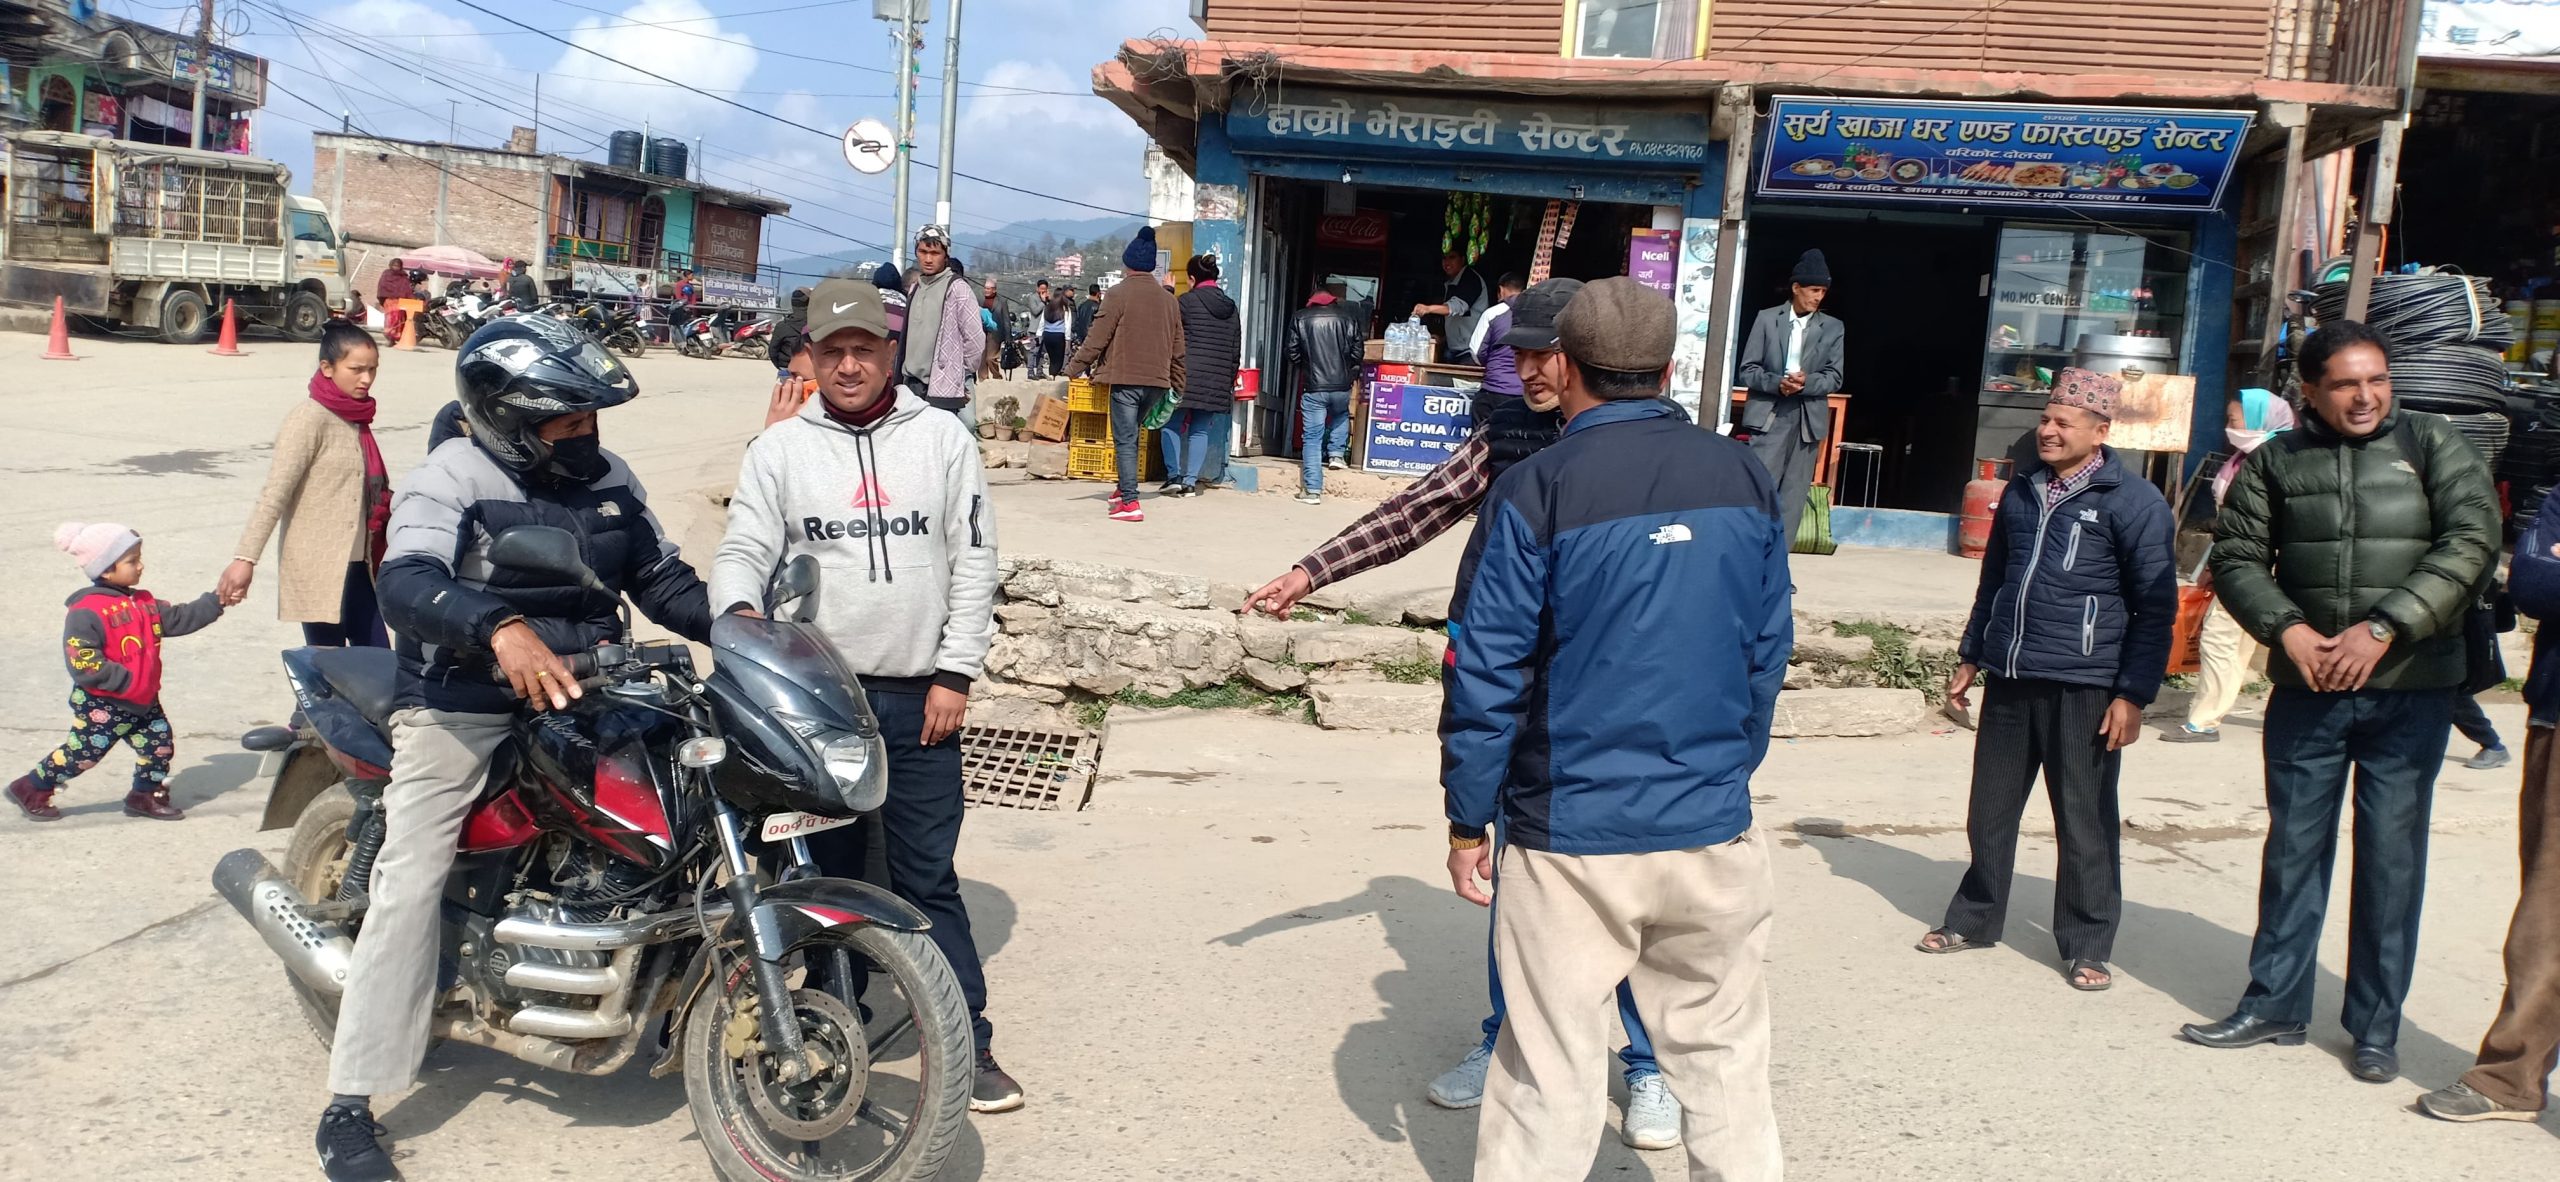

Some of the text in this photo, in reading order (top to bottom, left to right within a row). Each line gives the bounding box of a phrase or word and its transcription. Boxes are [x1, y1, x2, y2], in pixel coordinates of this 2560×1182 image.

[1267, 99, 1629, 157] हाम्रो भेराइटी सेन्टर
[1836, 116, 1906, 139] खाजा
[1959, 120, 2015, 143] एण्ड
[2021, 122, 2147, 152] फास्टफुड
[2152, 121, 2233, 151] सेन्टर
[1641, 250, 1670, 261] Ncell
[1400, 421, 1447, 435] CDMA
[803, 511, 930, 541] Reebok
